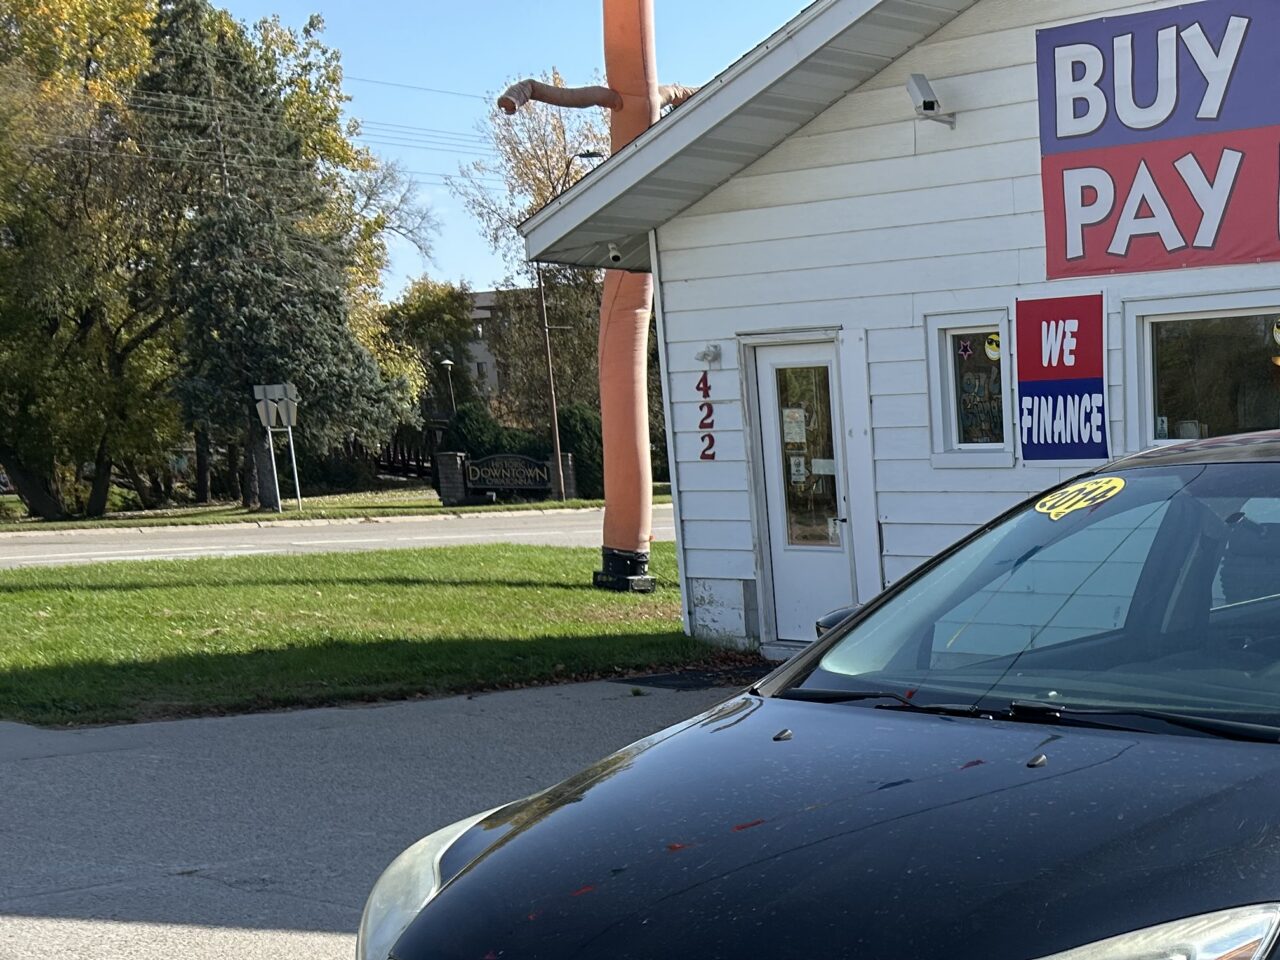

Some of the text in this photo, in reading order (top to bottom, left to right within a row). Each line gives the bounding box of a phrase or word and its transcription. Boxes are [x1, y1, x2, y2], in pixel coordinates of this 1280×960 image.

[1054, 16, 1249, 139] BUY
[1062, 149, 1243, 260] PAY
[1041, 319, 1079, 367] WE
[1021, 393, 1103, 444] FINANCE
[469, 465, 548, 481] DOWNTOWN
